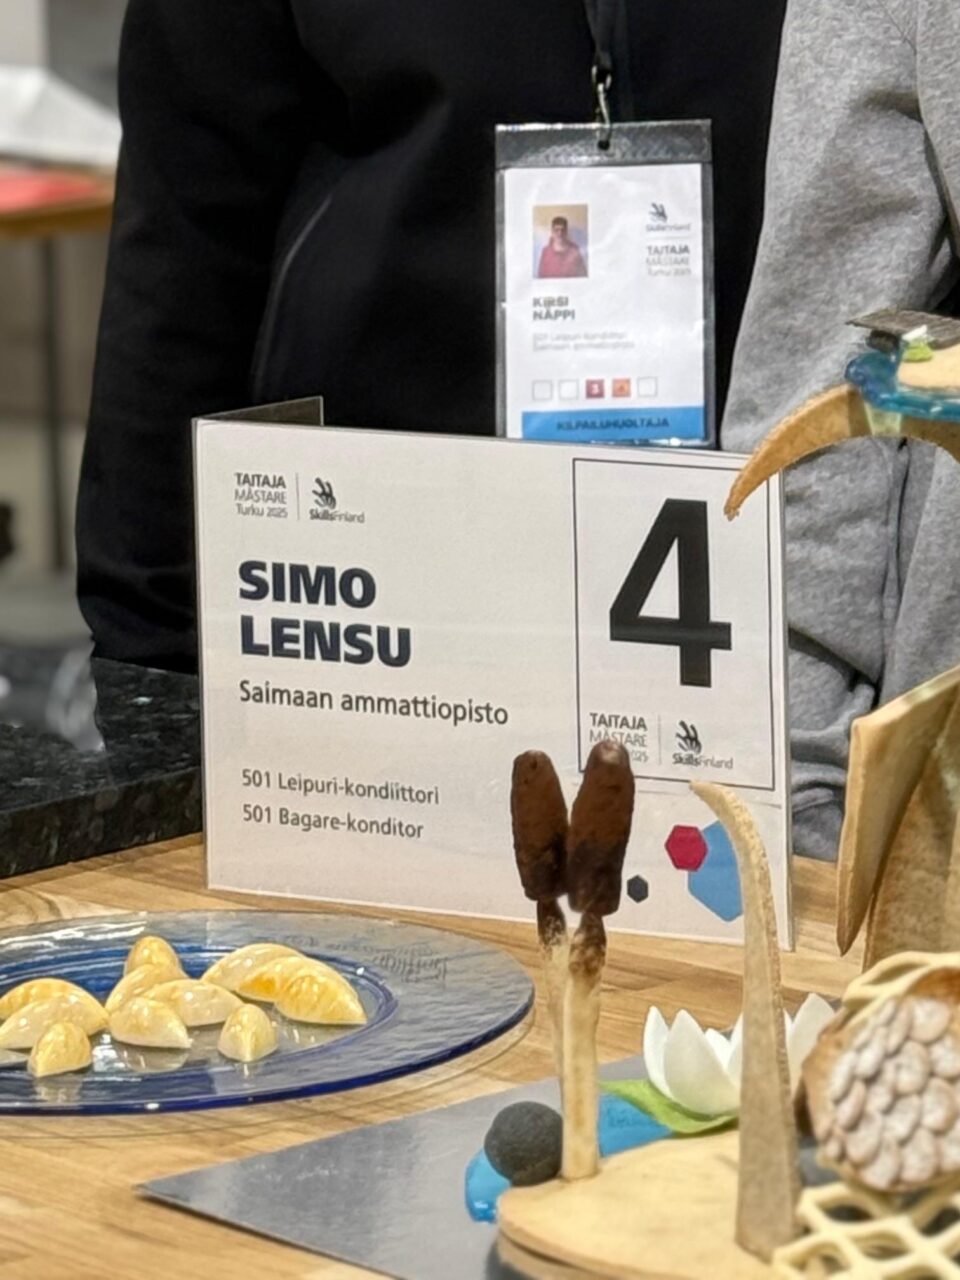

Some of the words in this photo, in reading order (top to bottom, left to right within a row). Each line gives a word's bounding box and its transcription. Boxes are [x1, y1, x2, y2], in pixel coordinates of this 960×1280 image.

[234, 487, 287, 505] MÄSTARE
[235, 472, 287, 489] TAITAJA
[239, 560, 376, 609] SIMO
[609, 498, 732, 688] 4
[240, 614, 411, 668] LENSU
[239, 680, 333, 710] Saimaan
[341, 694, 509, 726] ammattiopisto
[590, 712, 648, 732] TAITAJA
[242, 769, 271, 789] 501
[278, 772, 440, 805] Leipuri-kondiittori
[242, 804, 272, 823] 501
[278, 807, 424, 838] Bagare-konditor
